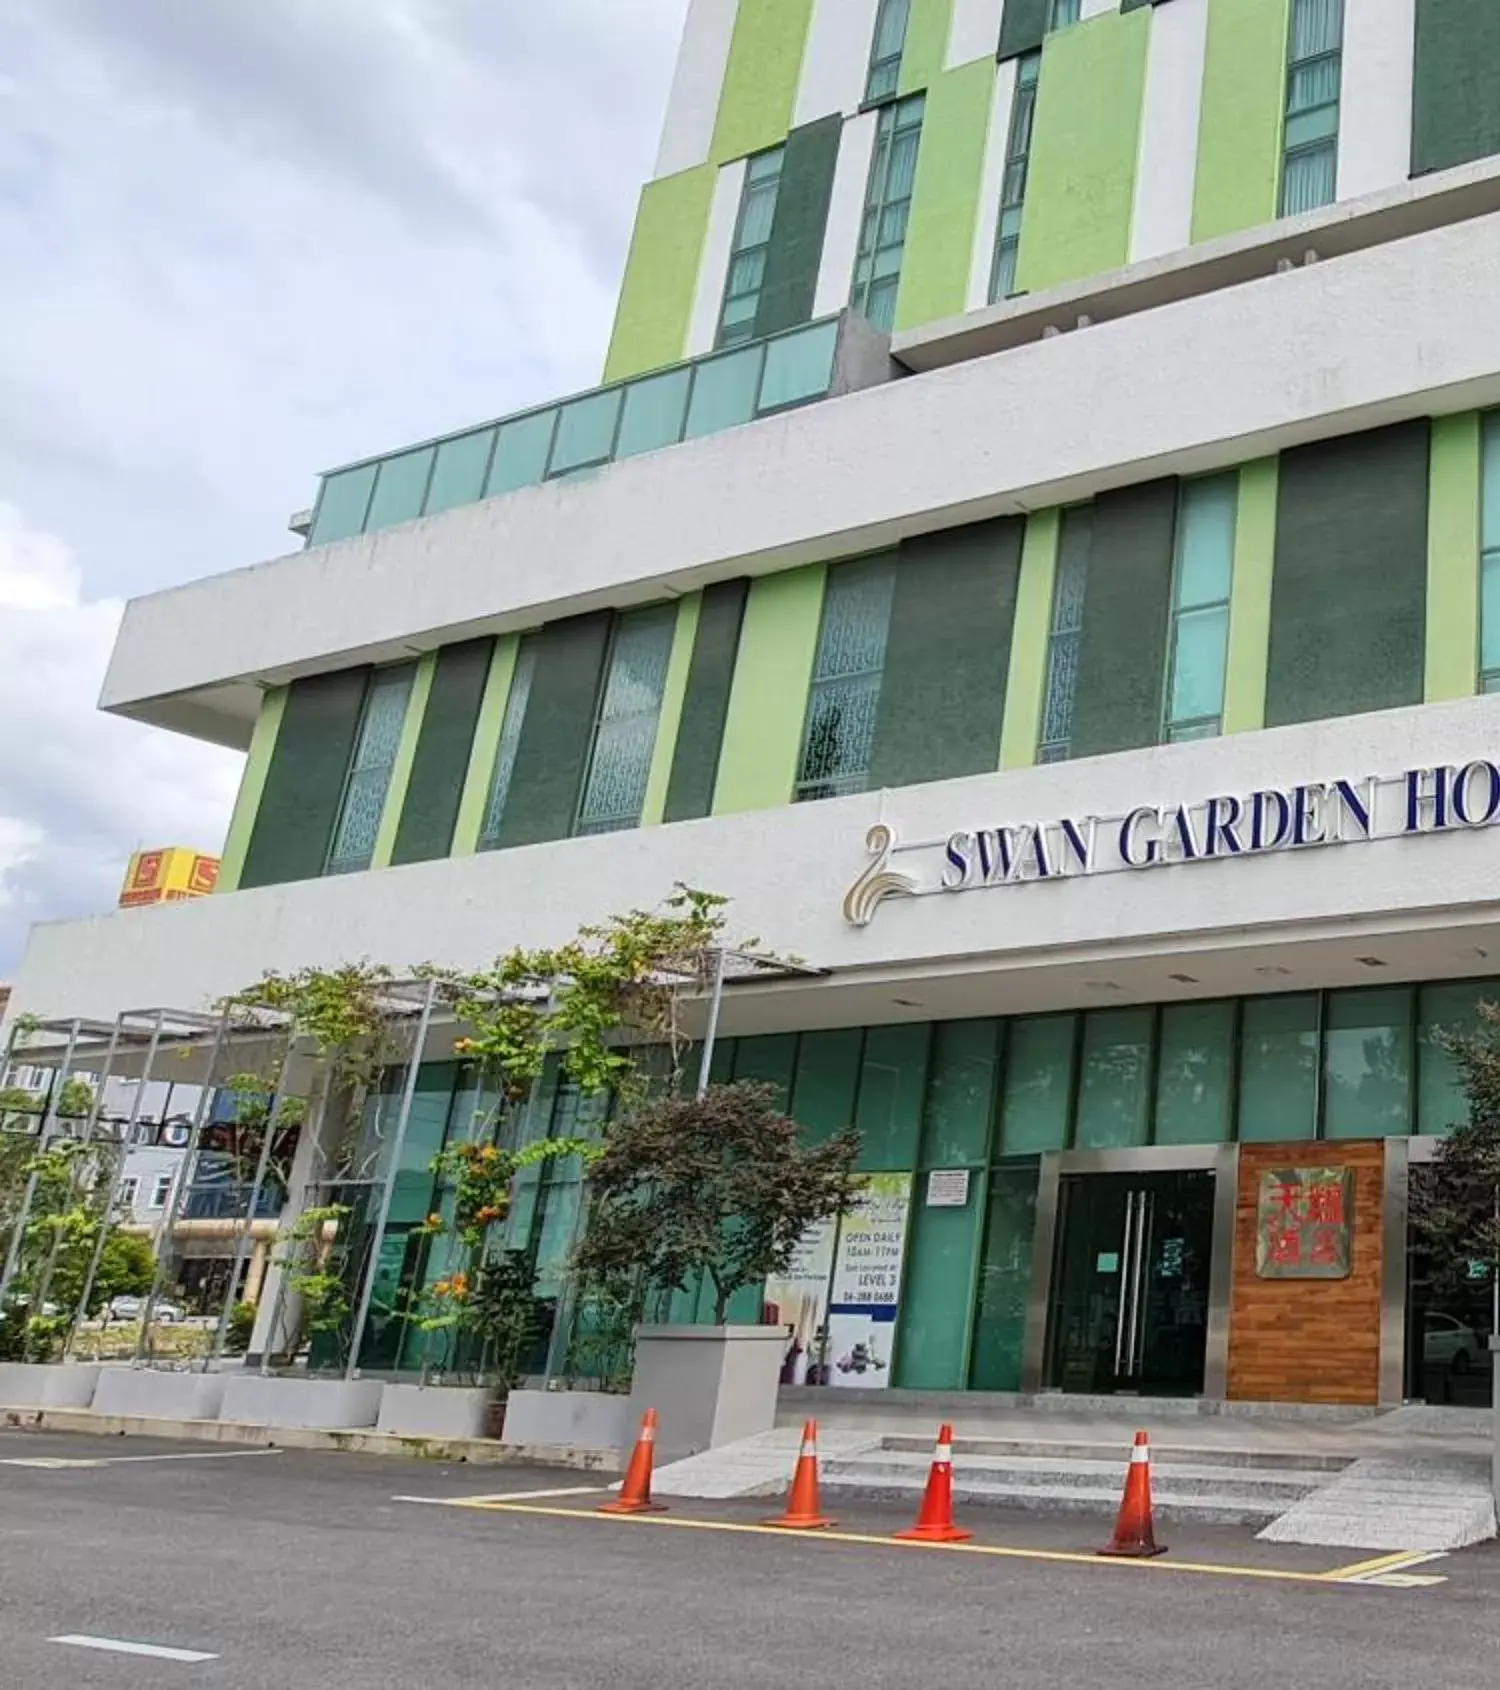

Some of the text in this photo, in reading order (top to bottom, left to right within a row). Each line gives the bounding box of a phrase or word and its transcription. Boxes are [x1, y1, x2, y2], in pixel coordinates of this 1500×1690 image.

[941, 815, 1100, 887] SWAN
[1119, 776, 1379, 867] GARDEN
[858, 1274, 887, 1287] LEVEL
